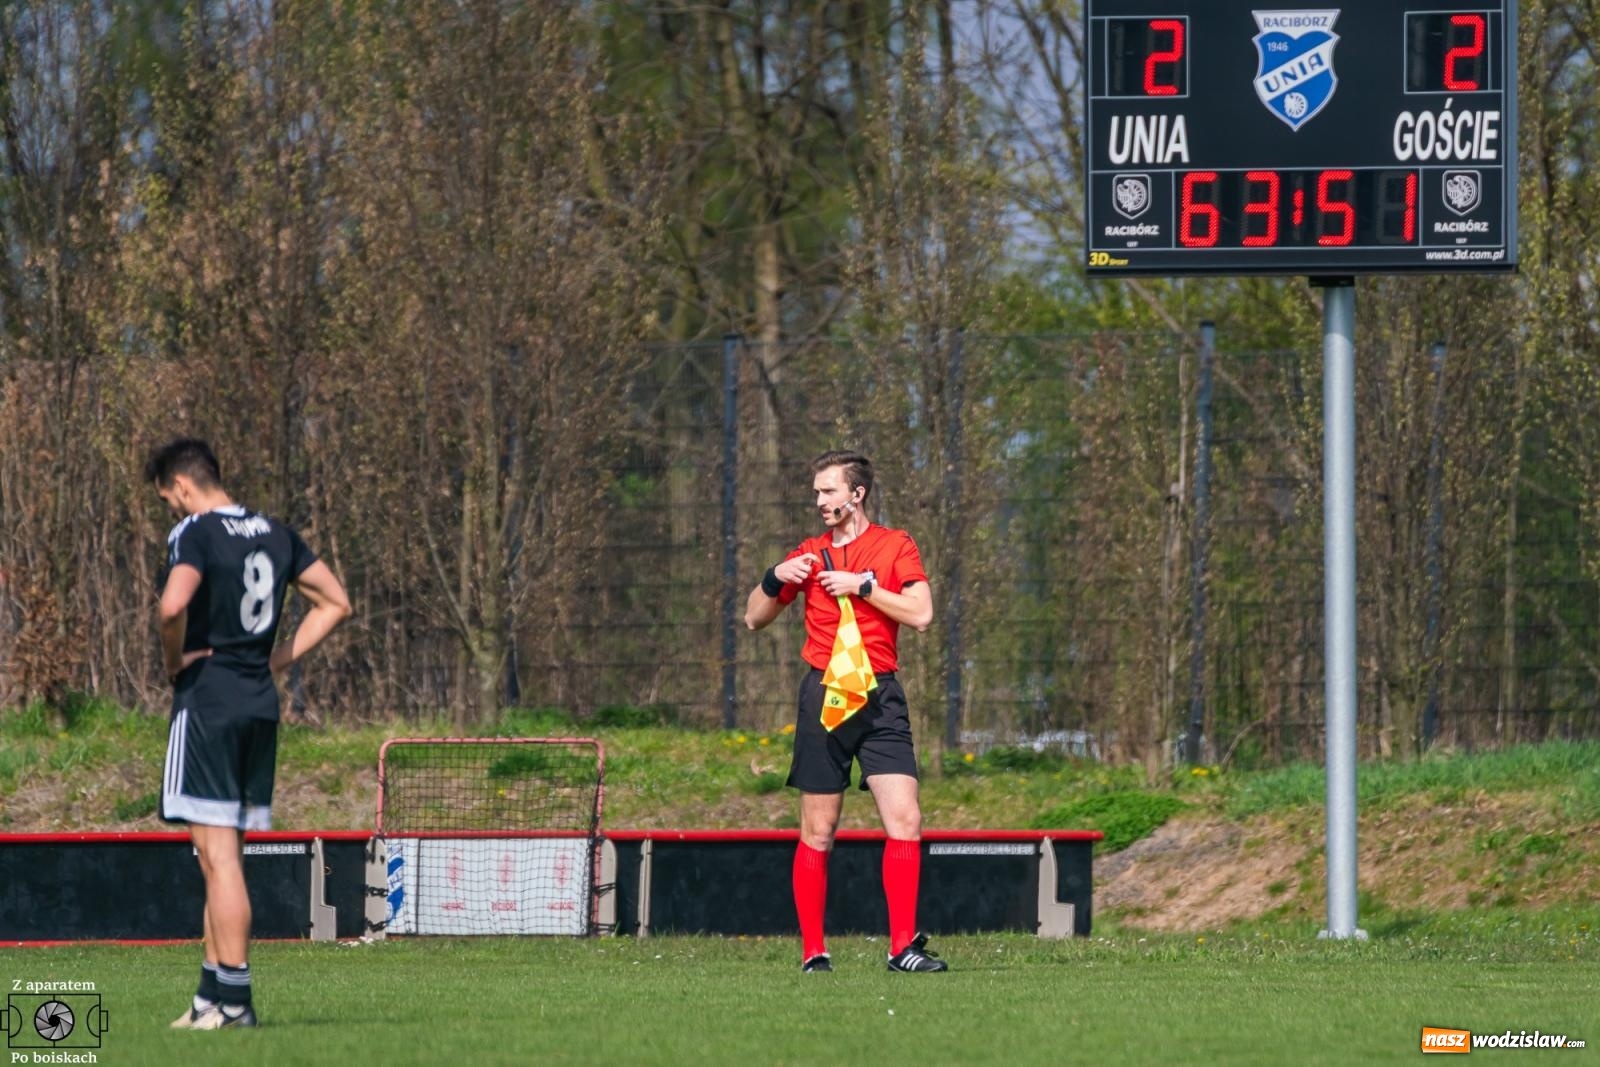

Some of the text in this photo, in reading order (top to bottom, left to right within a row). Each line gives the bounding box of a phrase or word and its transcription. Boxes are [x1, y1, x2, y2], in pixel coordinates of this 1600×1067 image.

[1263, 14, 1329, 28] RACIBÓRZ
[1143, 20, 1185, 96] 2
[1267, 41, 1289, 52] 1946
[1443, 15, 1485, 91] 2
[1263, 52, 1325, 93] UNIA
[1108, 114, 1190, 165] UNIA
[1393, 97, 1500, 161] GOŚCIE
[1104, 222, 1160, 236] RACIBÓRZ
[1433, 219, 1490, 233] RACIBÓRZ
[1089, 252, 1110, 266] 3D
[1425, 249, 1506, 262] www.3d.com.pl
[240, 551, 275, 635] 8
